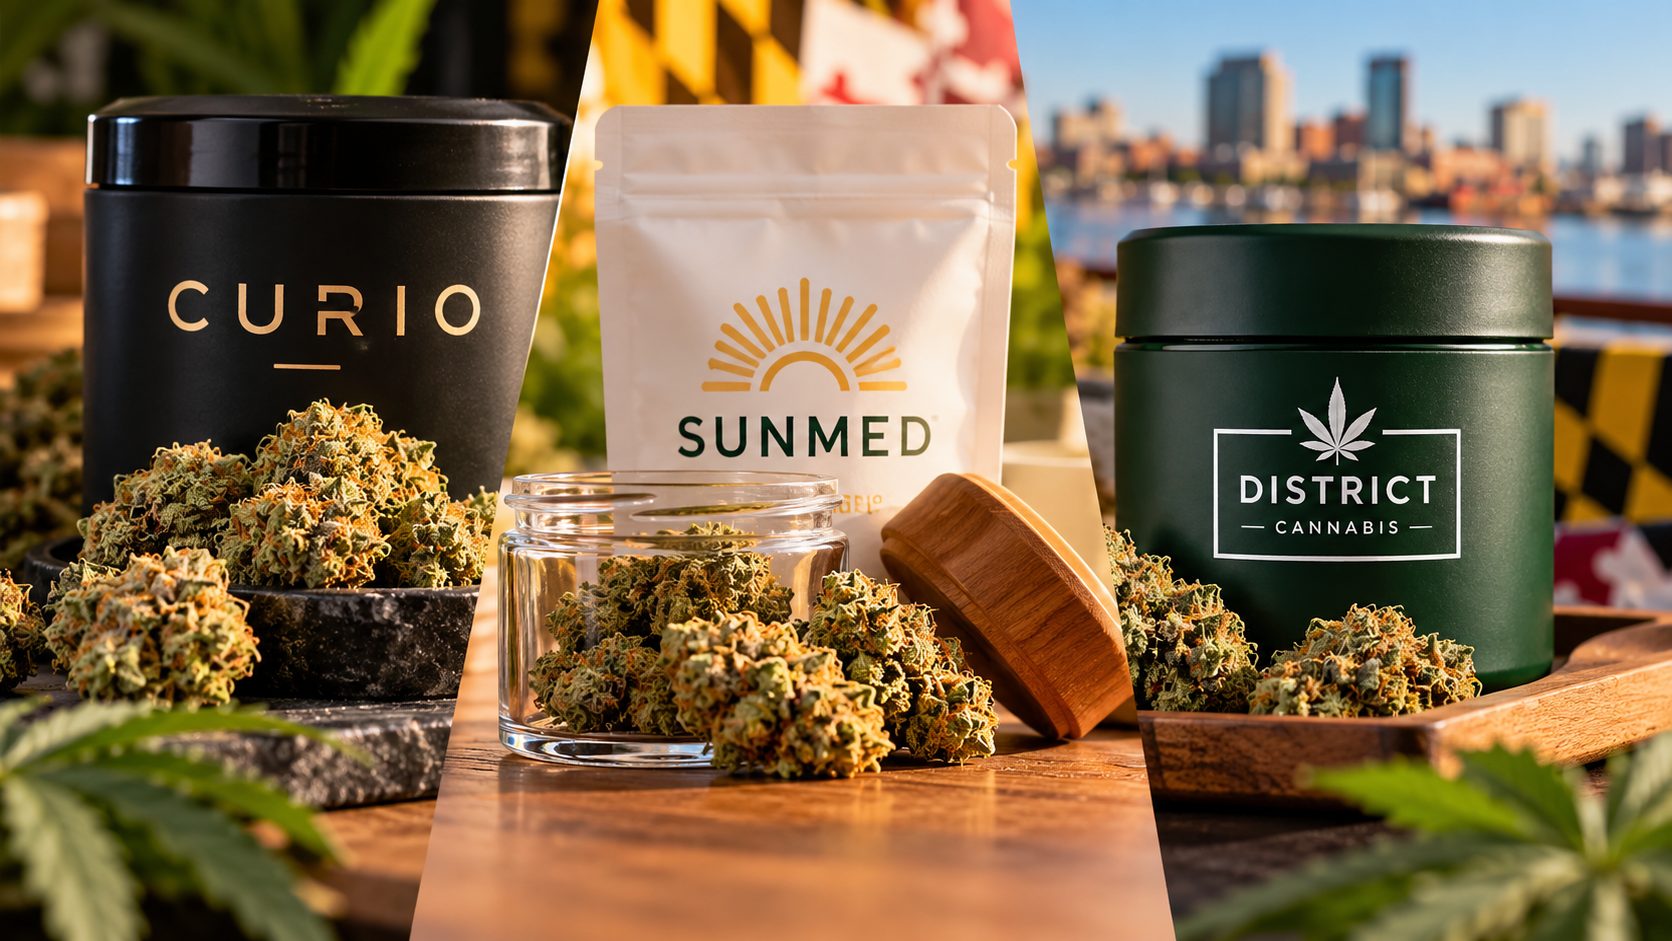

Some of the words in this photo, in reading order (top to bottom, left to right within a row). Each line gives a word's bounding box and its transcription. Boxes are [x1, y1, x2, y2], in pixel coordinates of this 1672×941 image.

[168, 280, 481, 336] CURIO
[678, 415, 931, 457] SUNMED
[1240, 475, 1437, 505] DISTRICT
[1276, 520, 1398, 535] CANNABIS
